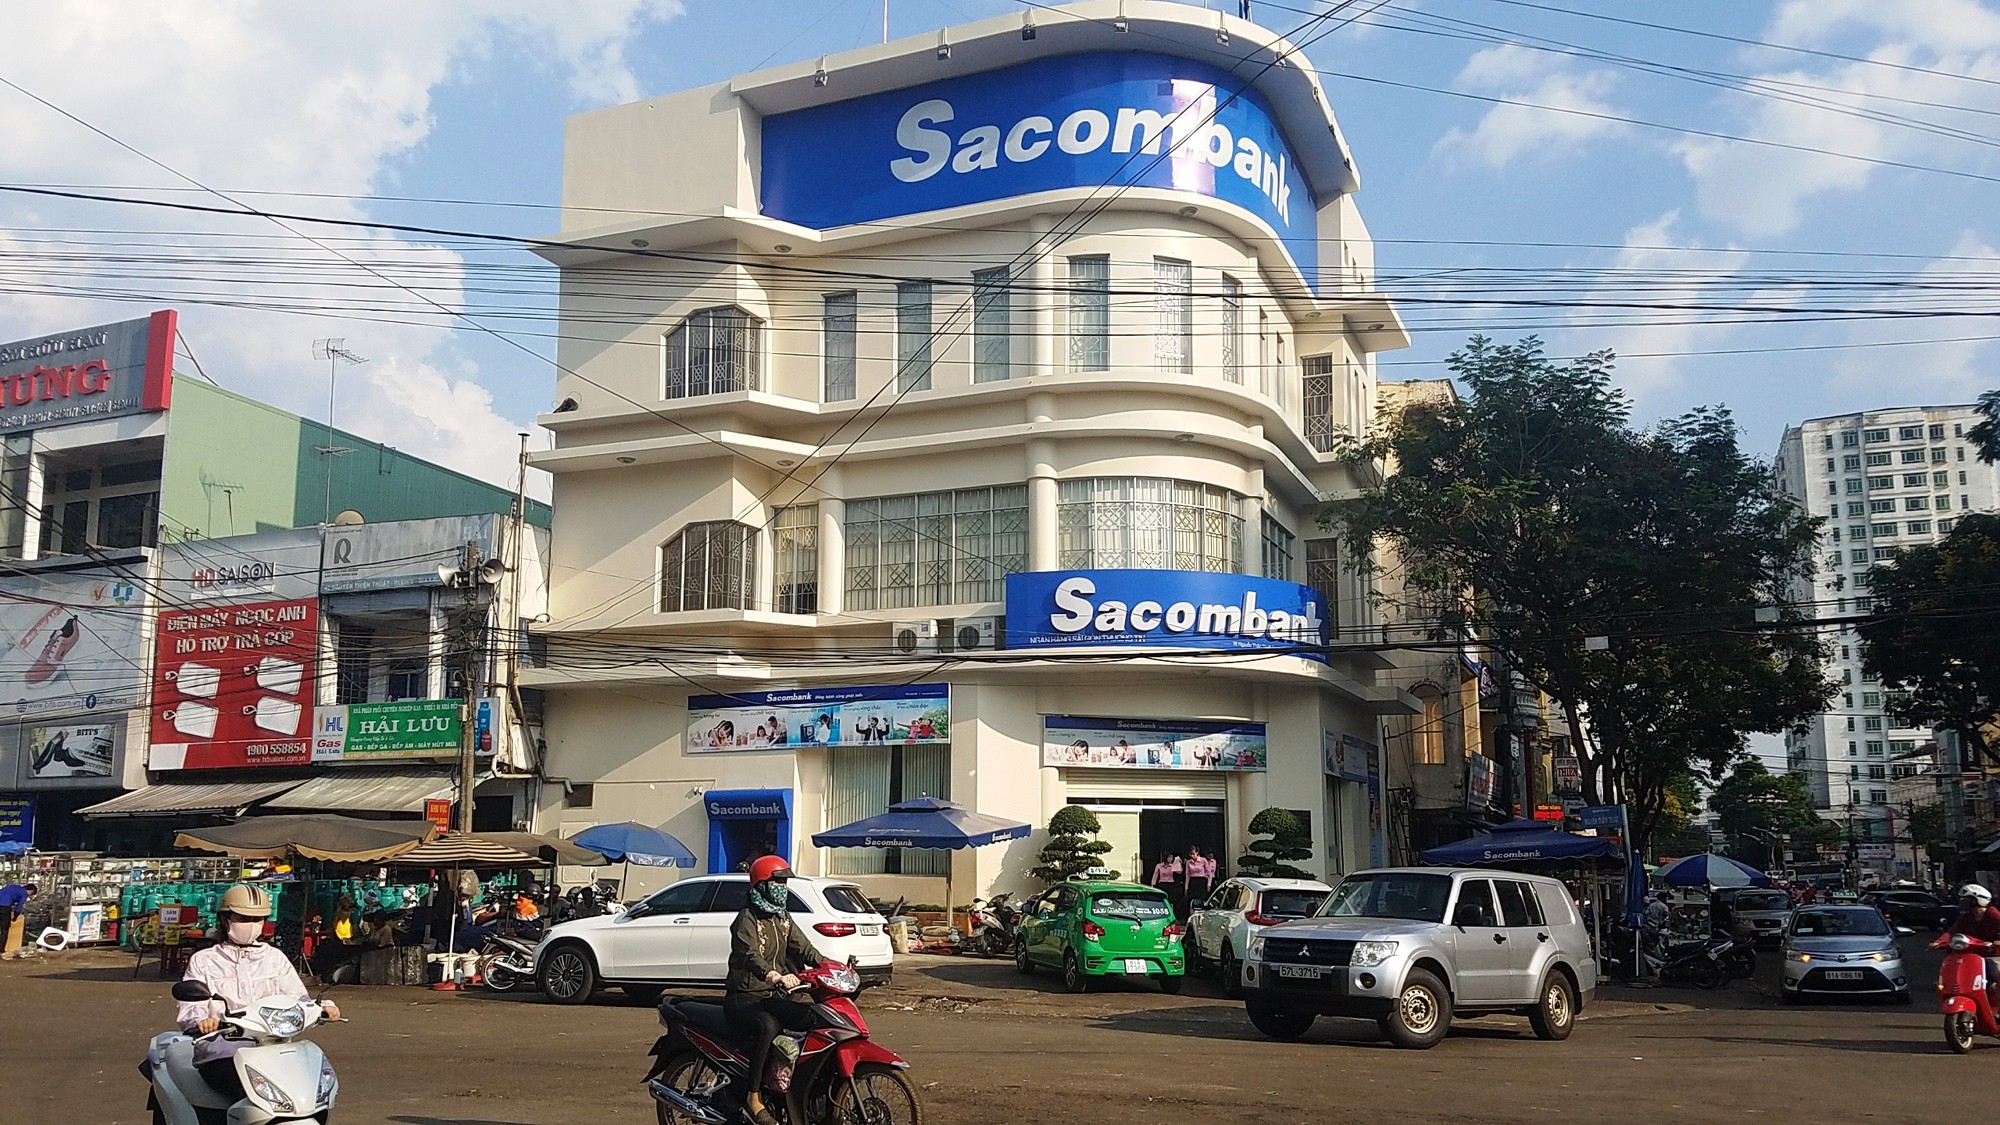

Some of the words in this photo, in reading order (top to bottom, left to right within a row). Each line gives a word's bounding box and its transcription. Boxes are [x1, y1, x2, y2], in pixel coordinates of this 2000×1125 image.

[890, 96, 1290, 228] Sacombank
[277, 606, 306, 621] ANH
[1050, 577, 1323, 646] Sacombank
[766, 692, 812, 702] Sacombank
[359, 716, 399, 734] HẢI
[406, 716, 450, 732] LƯU
[246, 744, 268, 755] 1900
[270, 743, 306, 754] 558854
[317, 739, 341, 747] Gas
[711, 802, 780, 815] Sacombank
[865, 837, 912, 846] Sacombank
[1484, 849, 1540, 859] Sacombank
